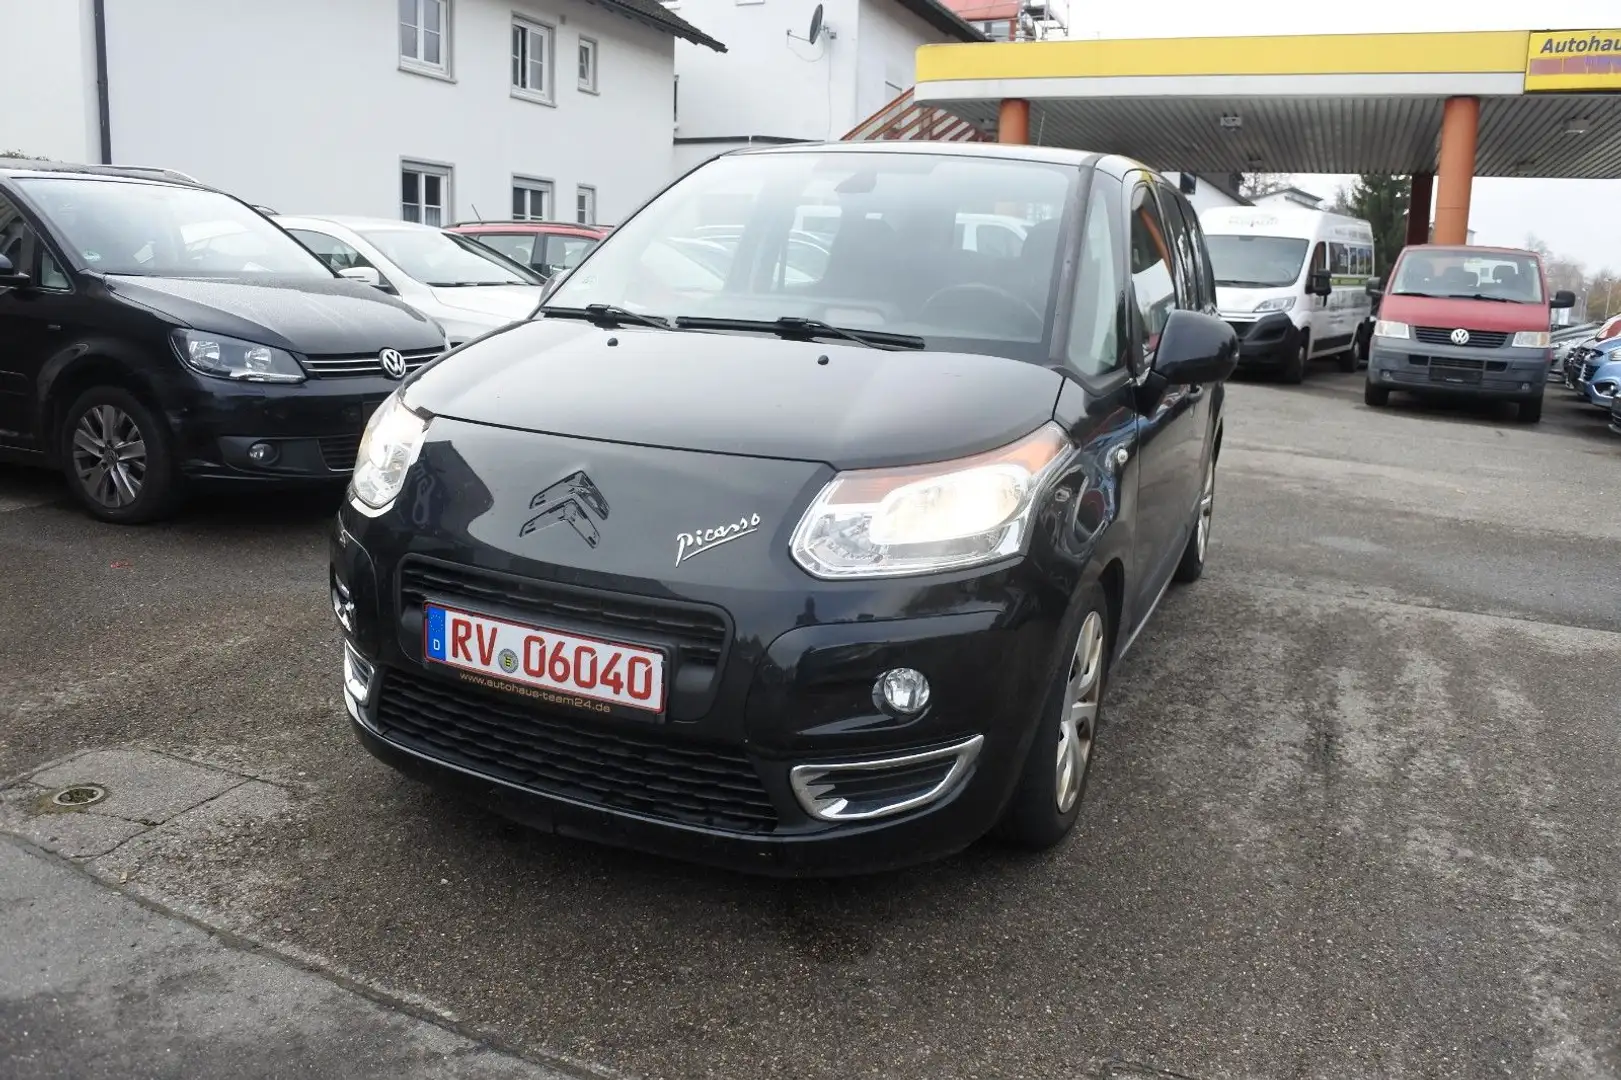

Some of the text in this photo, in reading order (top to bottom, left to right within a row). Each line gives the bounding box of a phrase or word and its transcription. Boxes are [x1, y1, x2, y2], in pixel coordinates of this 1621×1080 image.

[432, 639, 441, 651] D
[451, 617, 653, 701] RV 06040
[459, 671, 612, 713] www.autohaus-team24.de
